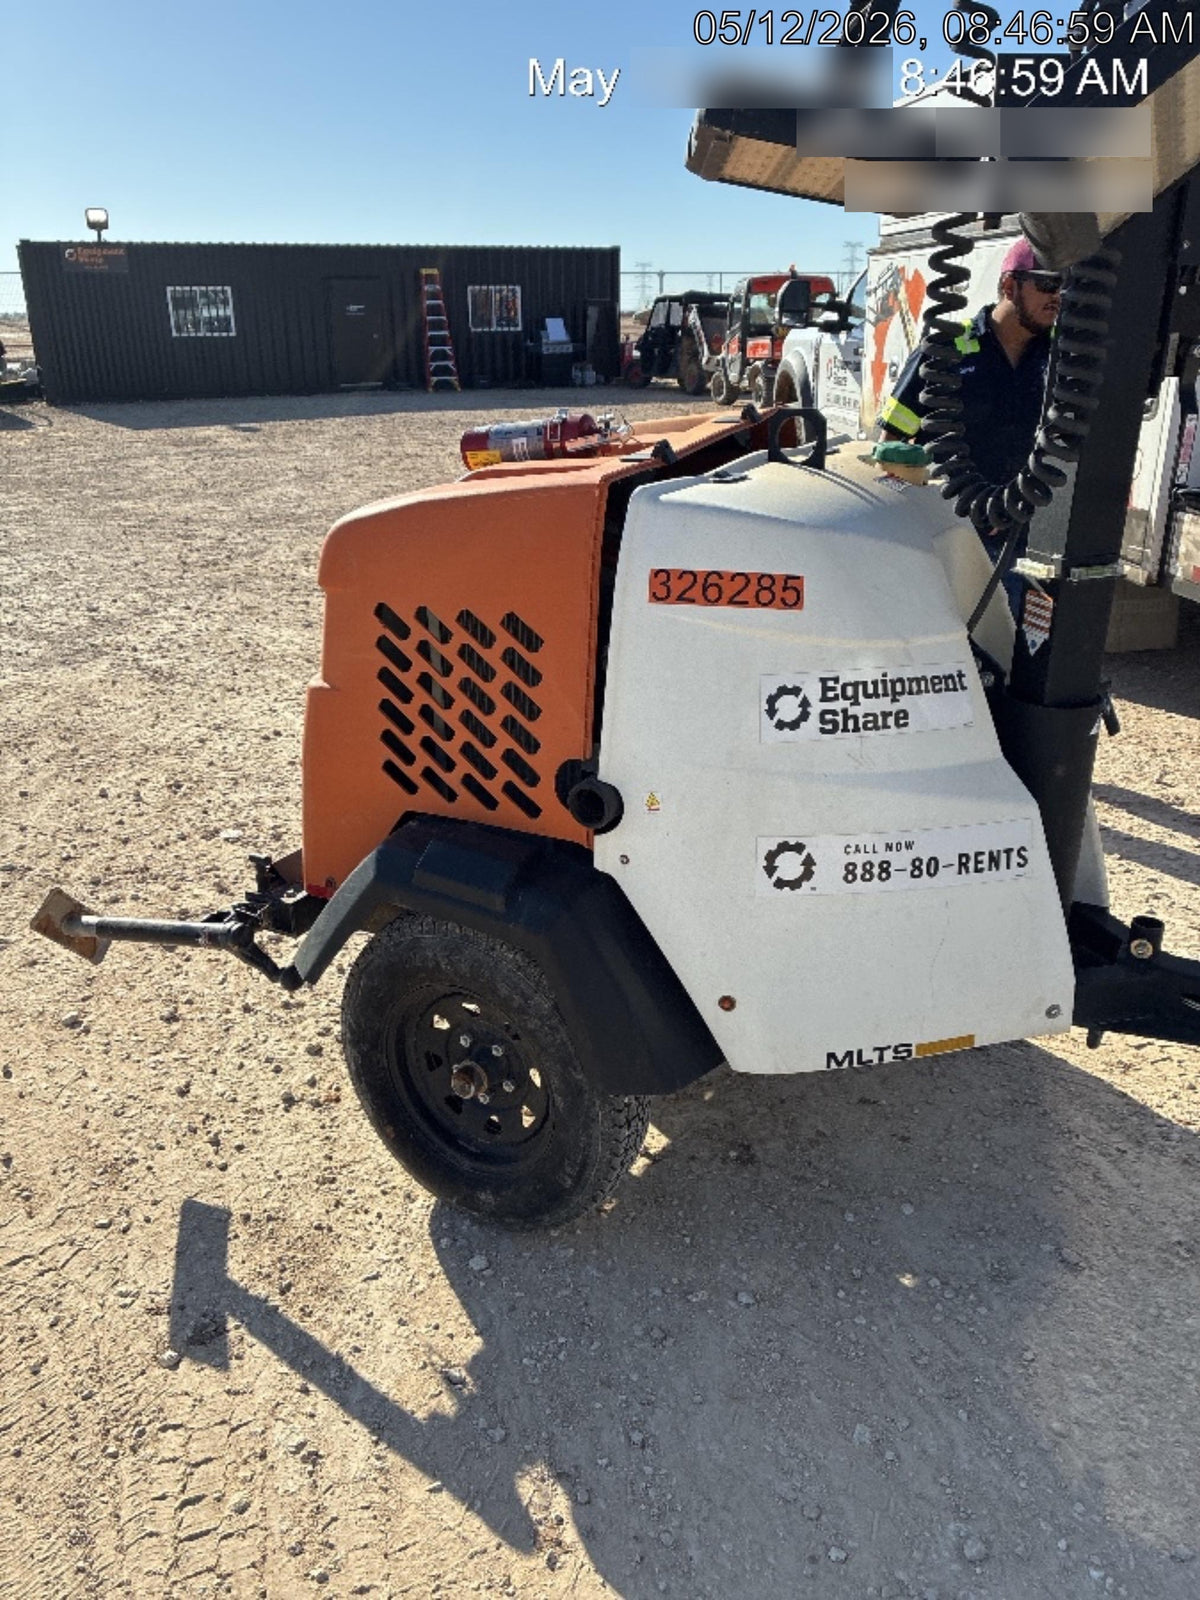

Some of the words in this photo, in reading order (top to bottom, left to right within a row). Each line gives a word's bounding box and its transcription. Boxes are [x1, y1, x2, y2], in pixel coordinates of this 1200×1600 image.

[651, 569, 801, 606] 326285
[819, 669, 967, 706] Equipment
[819, 706, 909, 735] Share
[843, 843, 879, 856] CALL
[884, 839, 915, 853] NOW
[842, 846, 1030, 884] 888-80-RENTS
[826, 1043, 913, 1069] MLTS
